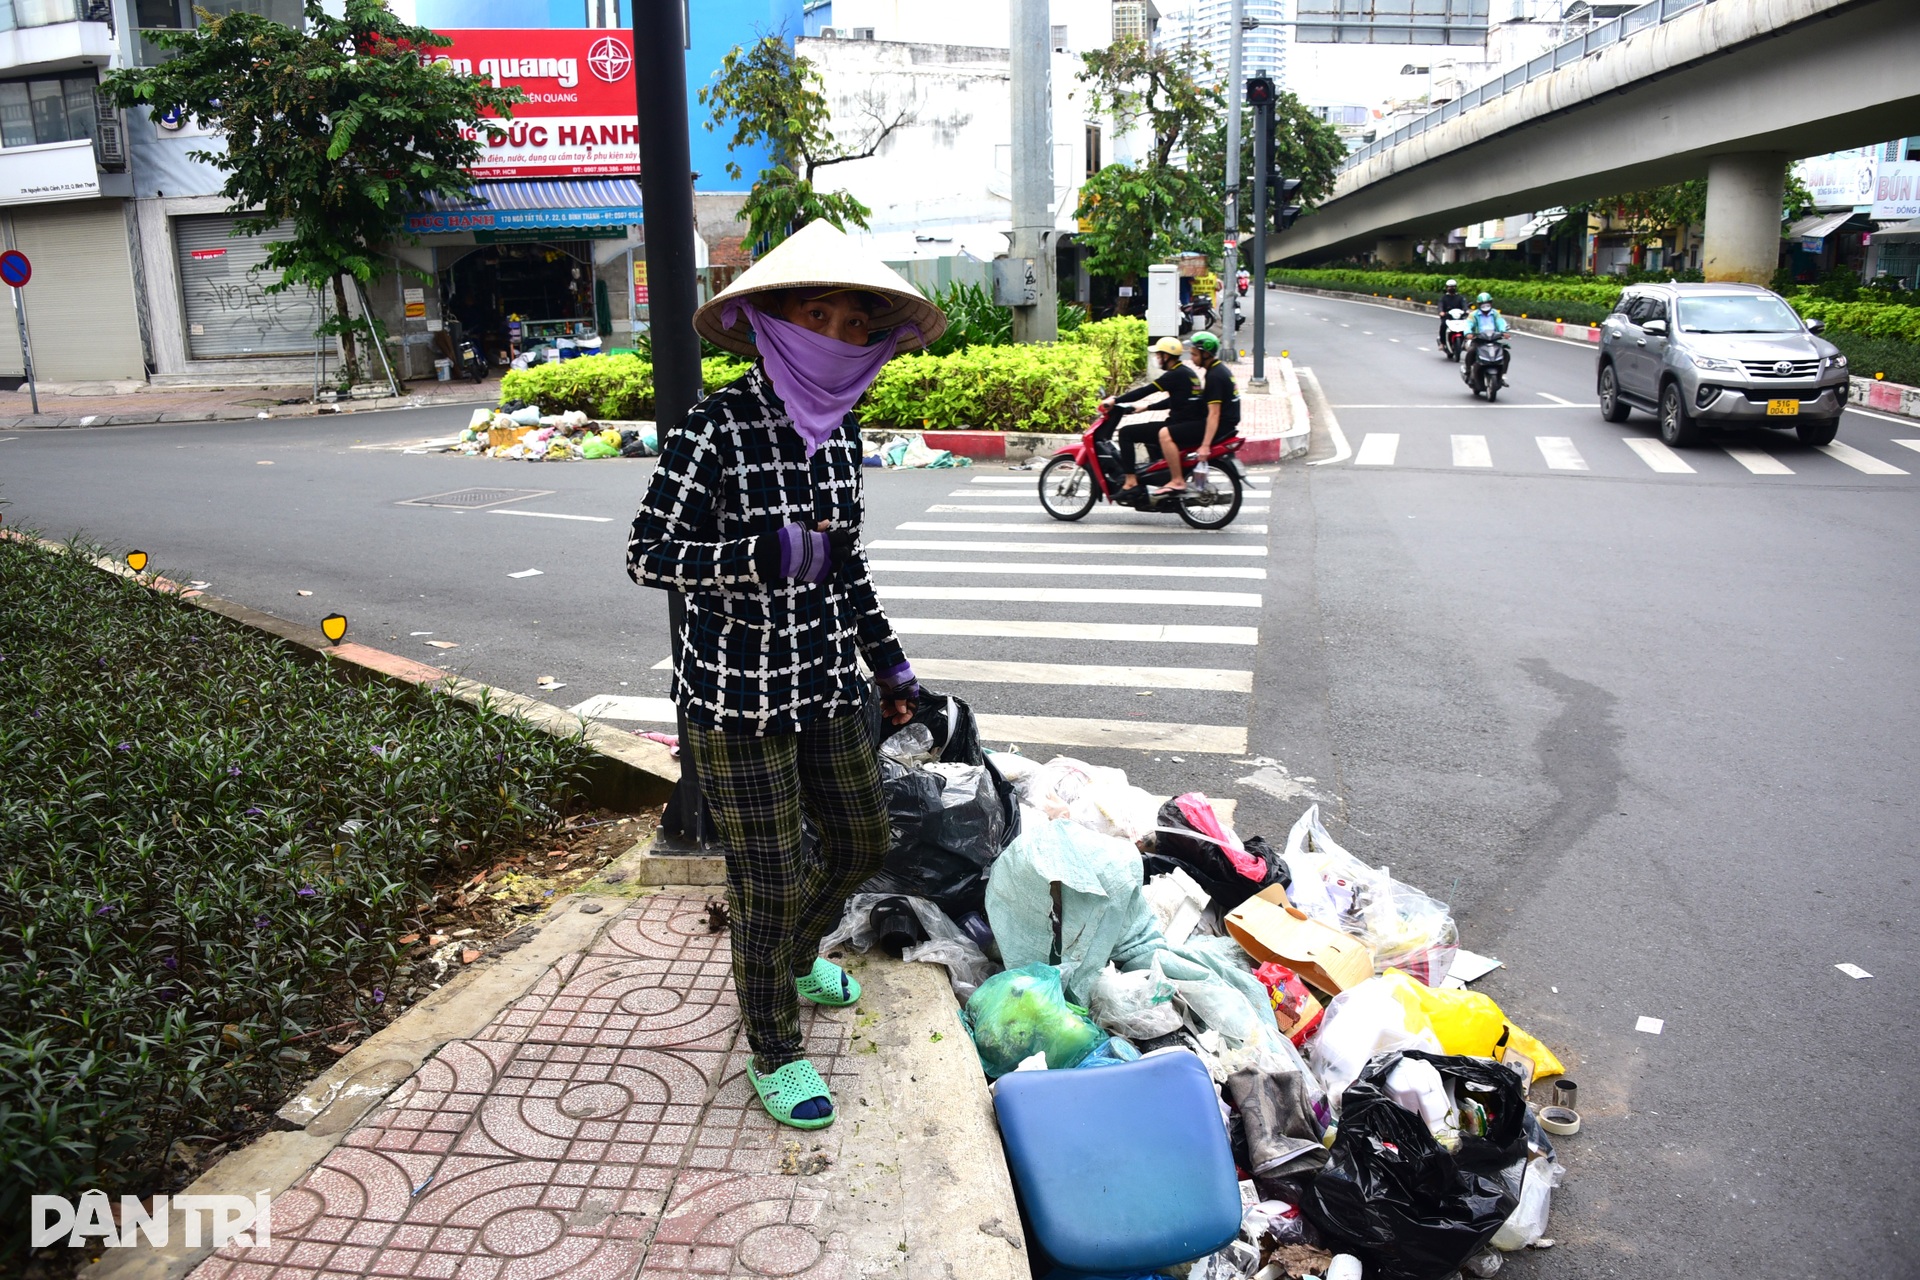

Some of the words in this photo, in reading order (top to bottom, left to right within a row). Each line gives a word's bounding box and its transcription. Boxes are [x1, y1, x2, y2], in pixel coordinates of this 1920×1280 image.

[479, 58, 579, 88] quang
[543, 93, 578, 104] QUANG
[487, 121, 548, 147] ĐỨC
[558, 125, 640, 151] HẠNH
[574, 153, 586, 162] tay
[587, 151, 593, 160] &
[593, 152, 608, 163] phụ
[609, 151, 624, 162] kiện
[1877, 169, 1913, 201] BÚN
[448, 214, 495, 228] HẠNH
